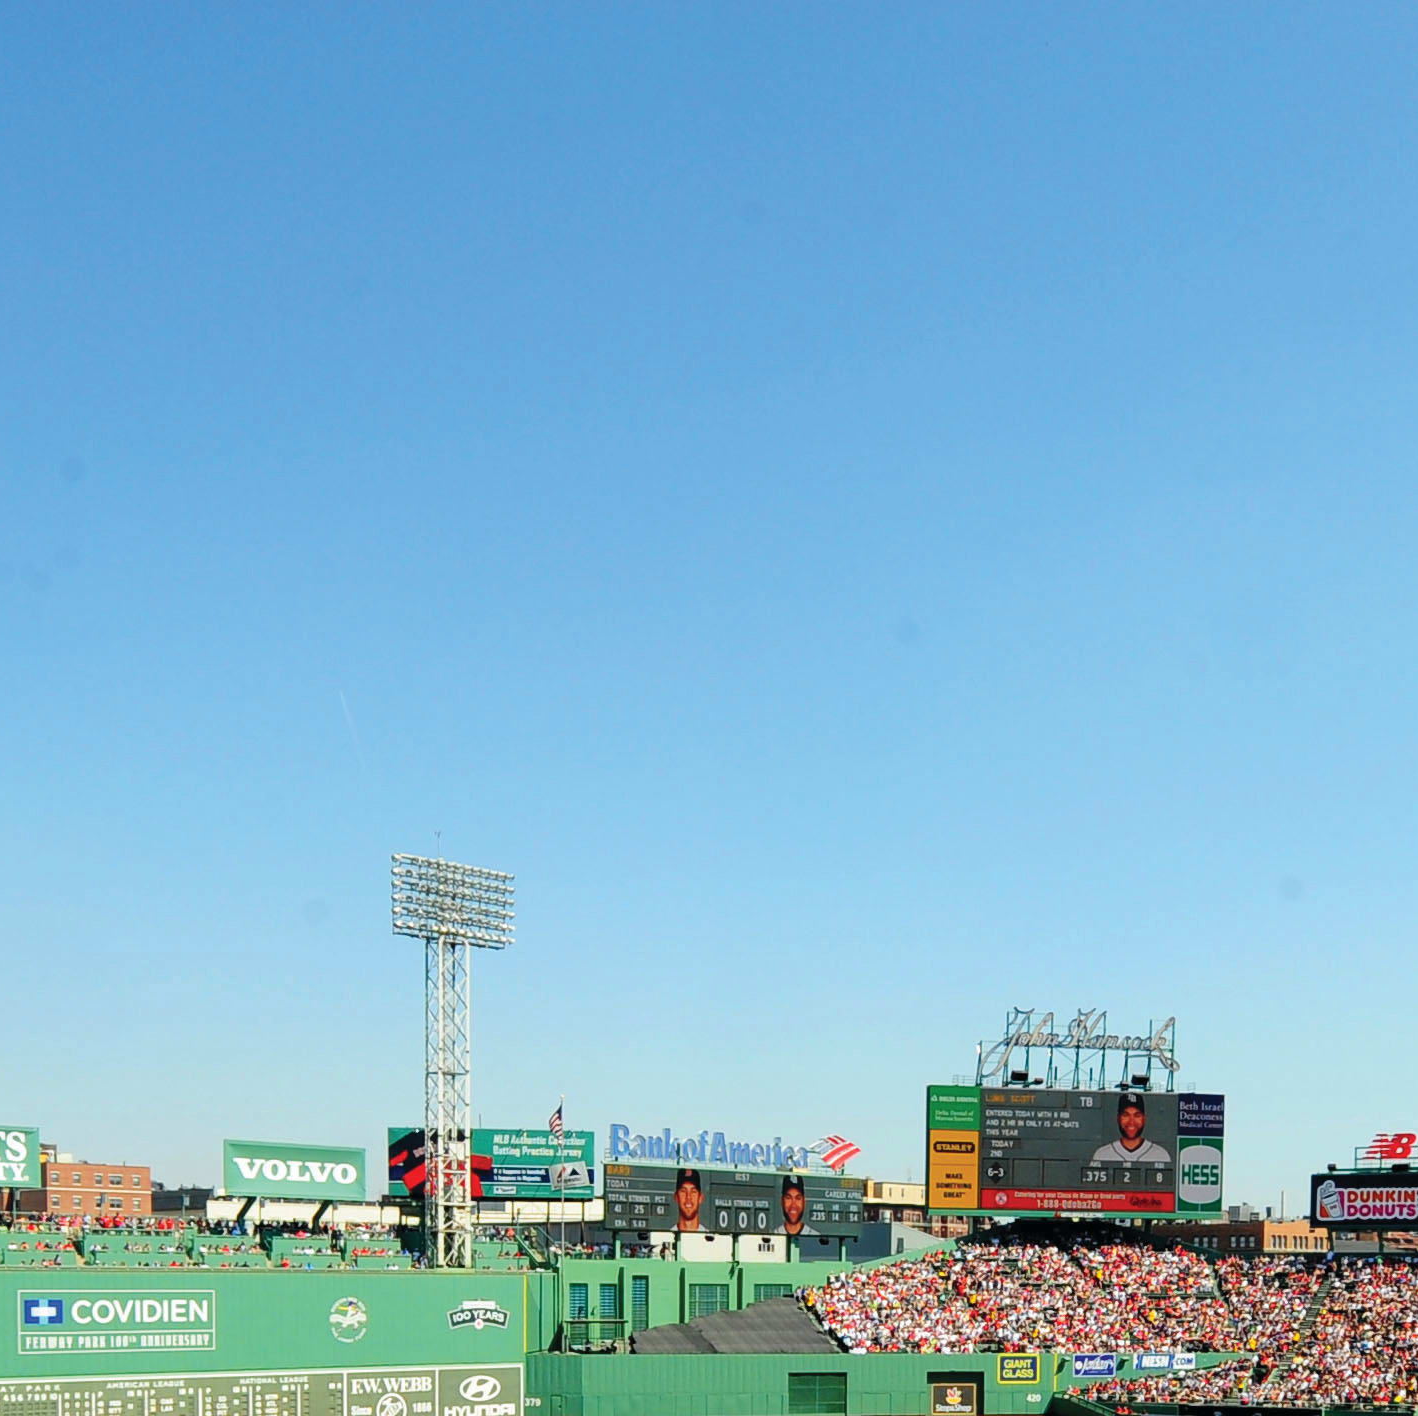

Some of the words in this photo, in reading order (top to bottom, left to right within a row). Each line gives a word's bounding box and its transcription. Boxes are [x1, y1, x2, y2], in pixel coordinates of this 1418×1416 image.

[1080, 1097, 1093, 1107] TB
[1179, 1101, 1198, 1110] Beth
[1015, 1110, 1036, 1118] TODAY
[1179, 1111, 1224, 1120] Deaconess
[610, 1124, 680, 1161] Bank
[680, 1130, 708, 1162] of
[709, 1131, 809, 1168] America
[991, 1140, 1014, 1148] TODAY
[233, 1157, 357, 1185] VOLVO
[1182, 1164, 1219, 1185] HESS
[1082, 1171, 1107, 1182] .375
[606, 1179, 630, 1188] TODAY
[634, 1205, 644, 1214] 25
[1347, 1203, 1416, 1219] DONUTS
[719, 1211, 728, 1228] 0
[739, 1211, 747, 1229] 0
[758, 1212, 767, 1229] 0
[71, 1299, 208, 1324] COVIDIEN
[452, 1310, 470, 1322] 100
[472, 1309, 505, 1322] YEARS
[25, 1335, 73, 1349] FENWAY
[78, 1335, 106, 1348] PARK
[1004, 1359, 1033, 1369] GIANT
[1142, 1355, 1170, 1367] NESN
[1002, 1369, 1034, 1378] GLASS
[26, 1384, 61, 1392] PARK
[106, 1381, 150, 1389] AMERICAN
[351, 1378, 382, 1395] F.W.
[385, 1377, 432, 1393] WEBB
[524, 1398, 541, 1407] 379
[1026, 1394, 1041, 1402] 420
